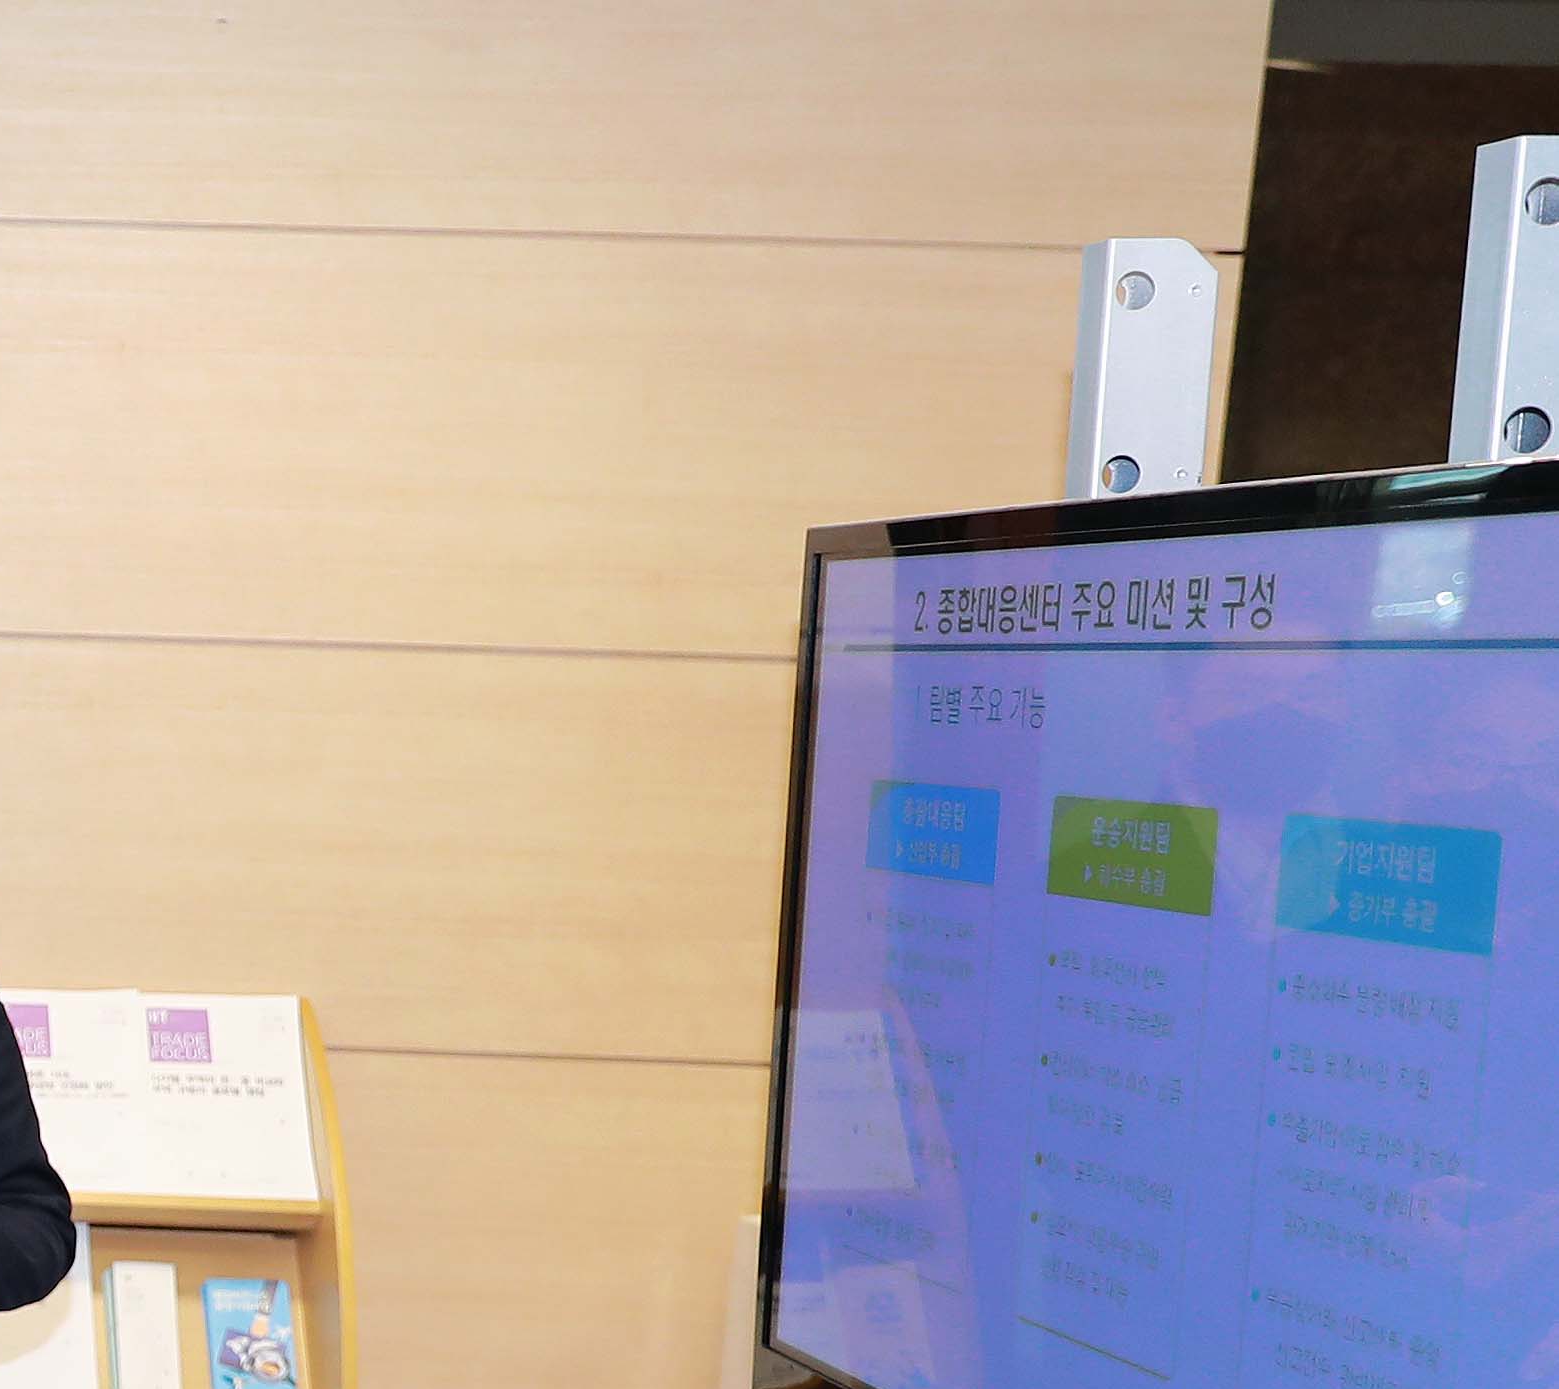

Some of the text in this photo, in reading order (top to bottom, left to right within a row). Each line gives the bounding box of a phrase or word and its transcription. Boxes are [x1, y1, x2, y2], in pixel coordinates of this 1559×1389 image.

[937, 584, 1063, 635] 종합대응센터
[1070, 581, 1117, 633] 주요
[1126, 577, 1176, 631] 미션
[1184, 575, 1211, 631] 및
[1220, 573, 1277, 631] 구성
[929, 685, 1047, 730] 팀별 주요 기능
[1091, 815, 1171, 856] 운송지원팀
[1335, 838, 1437, 886] 기업지원팀
